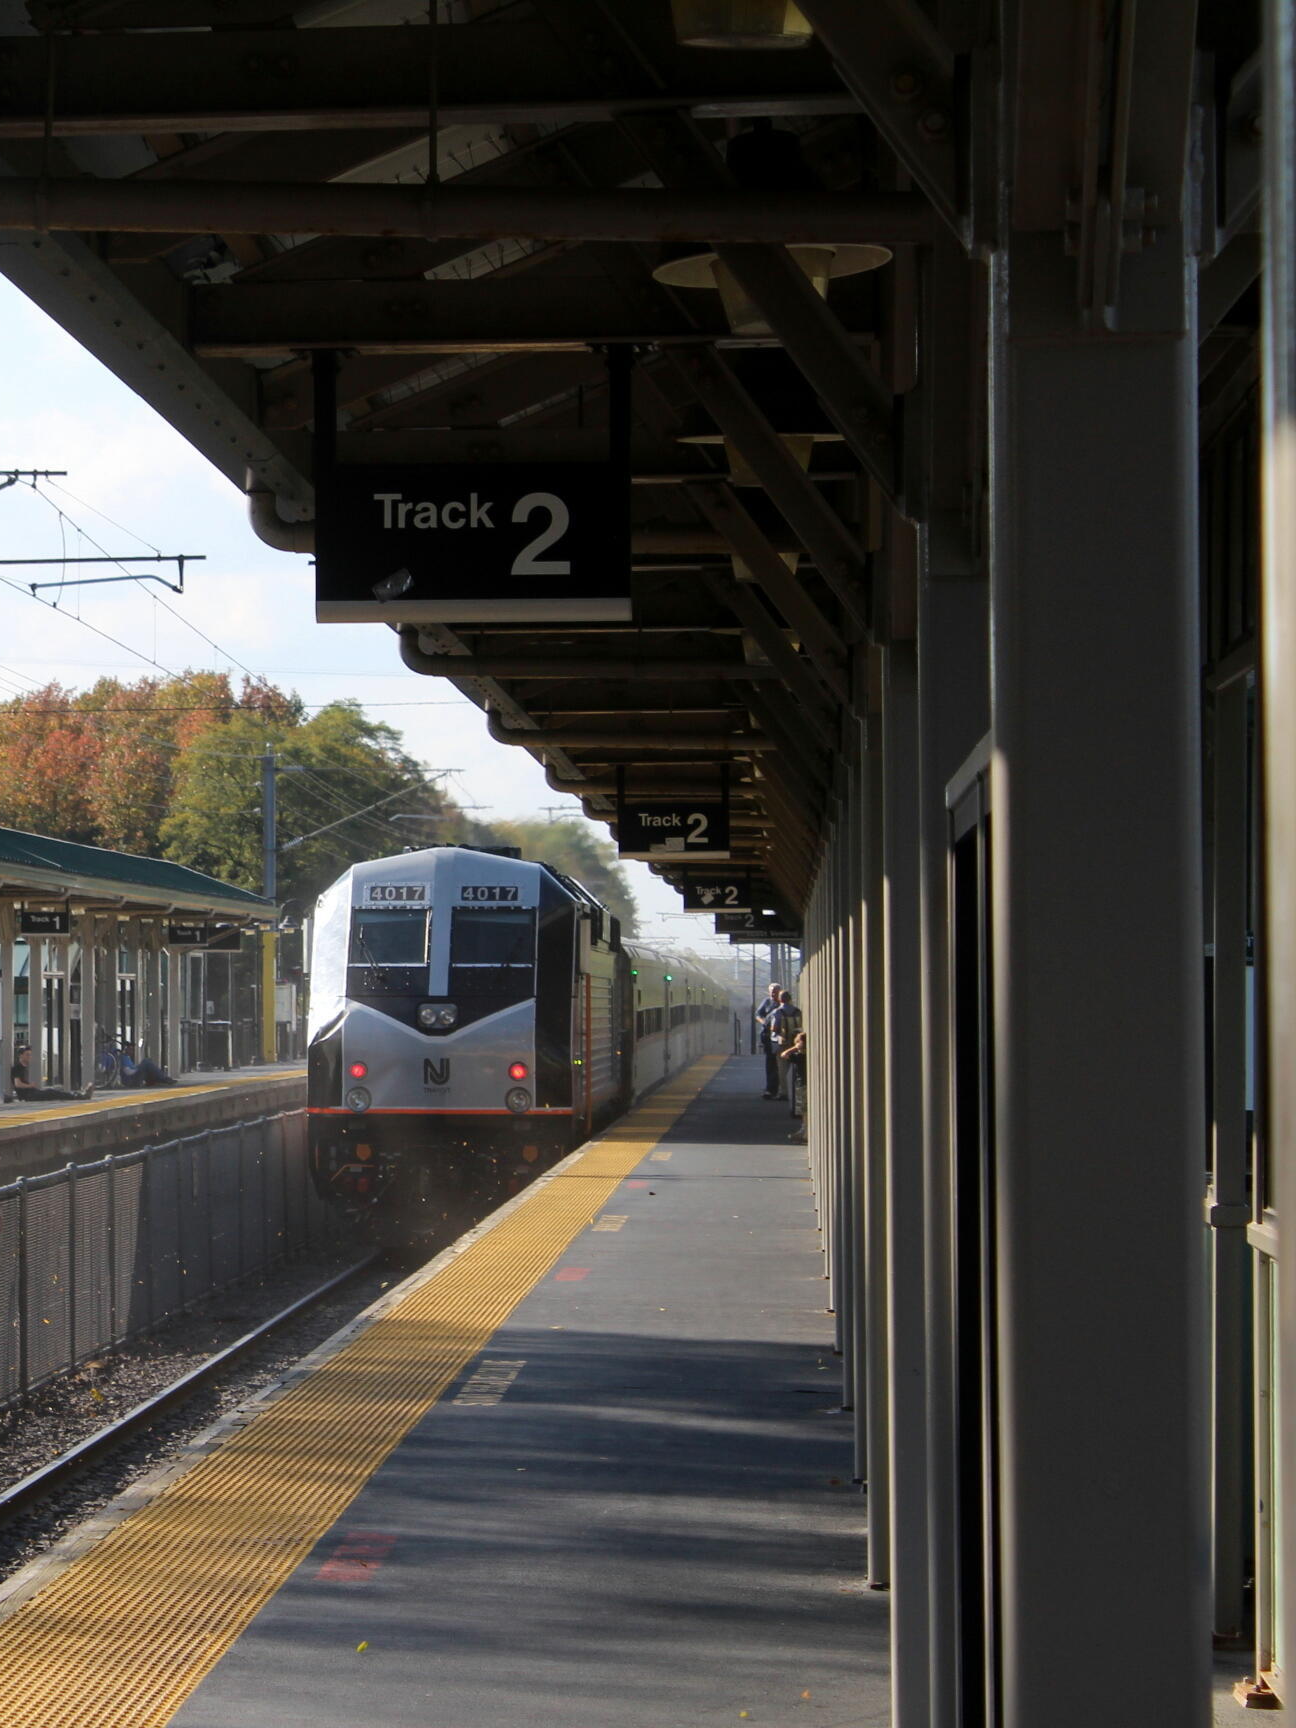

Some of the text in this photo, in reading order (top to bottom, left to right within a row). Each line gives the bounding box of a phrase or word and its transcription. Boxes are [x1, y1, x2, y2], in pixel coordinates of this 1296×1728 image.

[373, 492, 571, 576] Track 2
[638, 812, 709, 843] Track 2
[371, 887, 423, 901] 4017
[463, 887, 517, 901] 4017
[695, 886, 739, 905] Track 2
[52, 916, 60, 930] 1
[744, 913, 755, 928] 2
